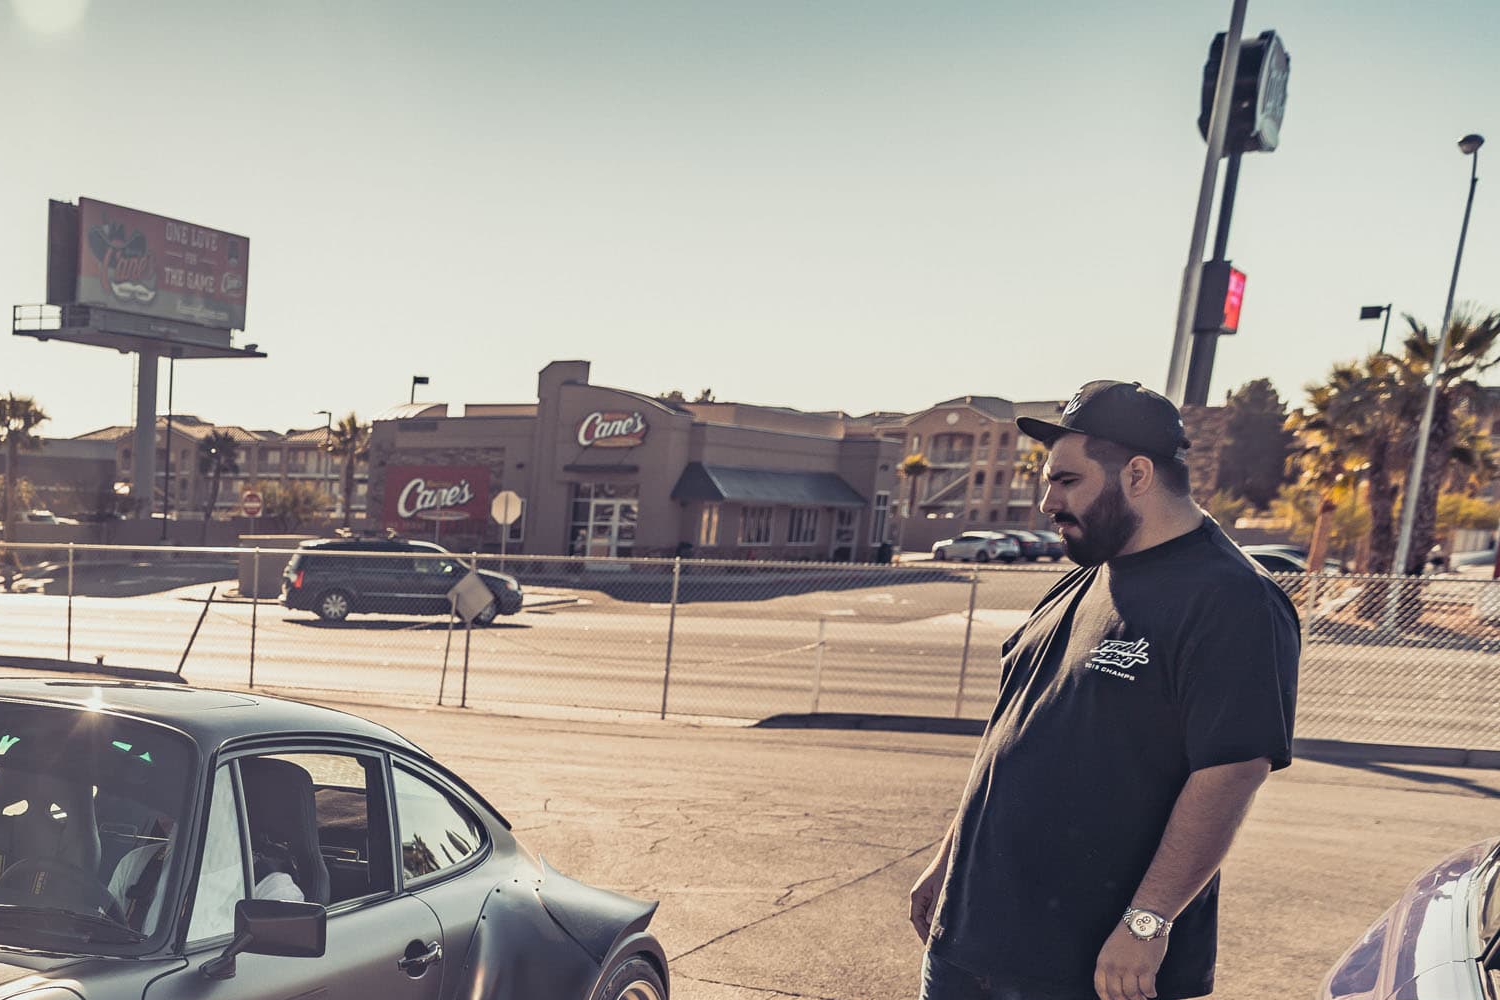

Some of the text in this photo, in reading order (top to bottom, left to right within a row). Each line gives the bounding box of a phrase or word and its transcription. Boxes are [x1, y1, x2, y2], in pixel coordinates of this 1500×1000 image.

[165, 222, 219, 252] ONE LOVE
[164, 267, 216, 294] THE GAME
[578, 411, 645, 446] Cane's
[397, 478, 474, 518] Cane's
